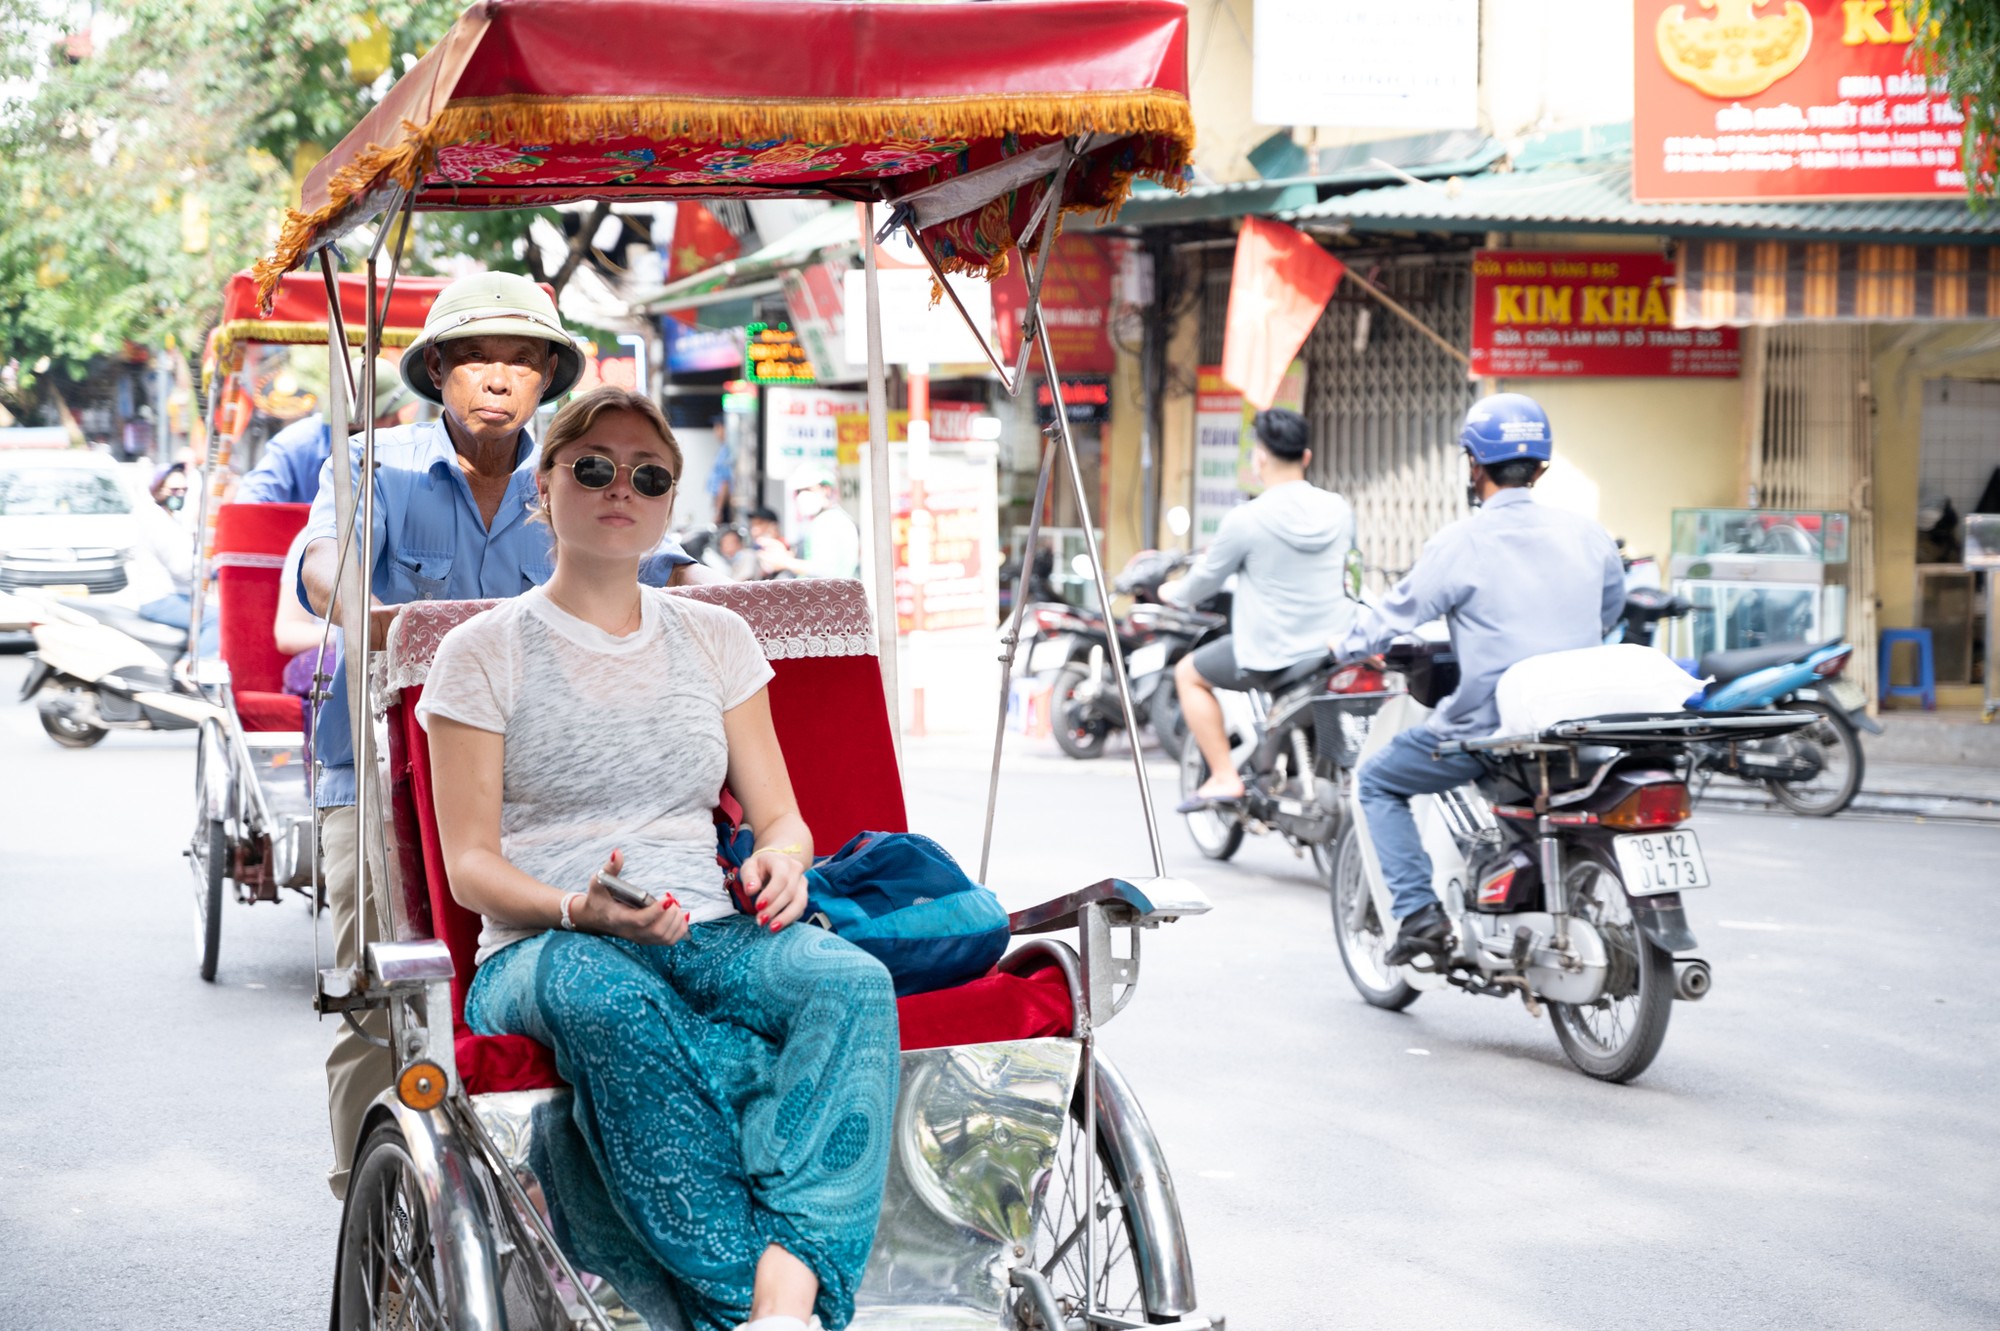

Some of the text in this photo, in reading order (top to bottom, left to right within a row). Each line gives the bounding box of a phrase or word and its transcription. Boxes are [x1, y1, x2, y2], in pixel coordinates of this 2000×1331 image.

[1506, 259, 1546, 277] HÀNG
[1552, 259, 1588, 277] VÀNG
[1591, 262, 1619, 279] BẠC
[1494, 275, 1677, 325] KIM KHÁ
[1648, 331, 1692, 346] TRANG
